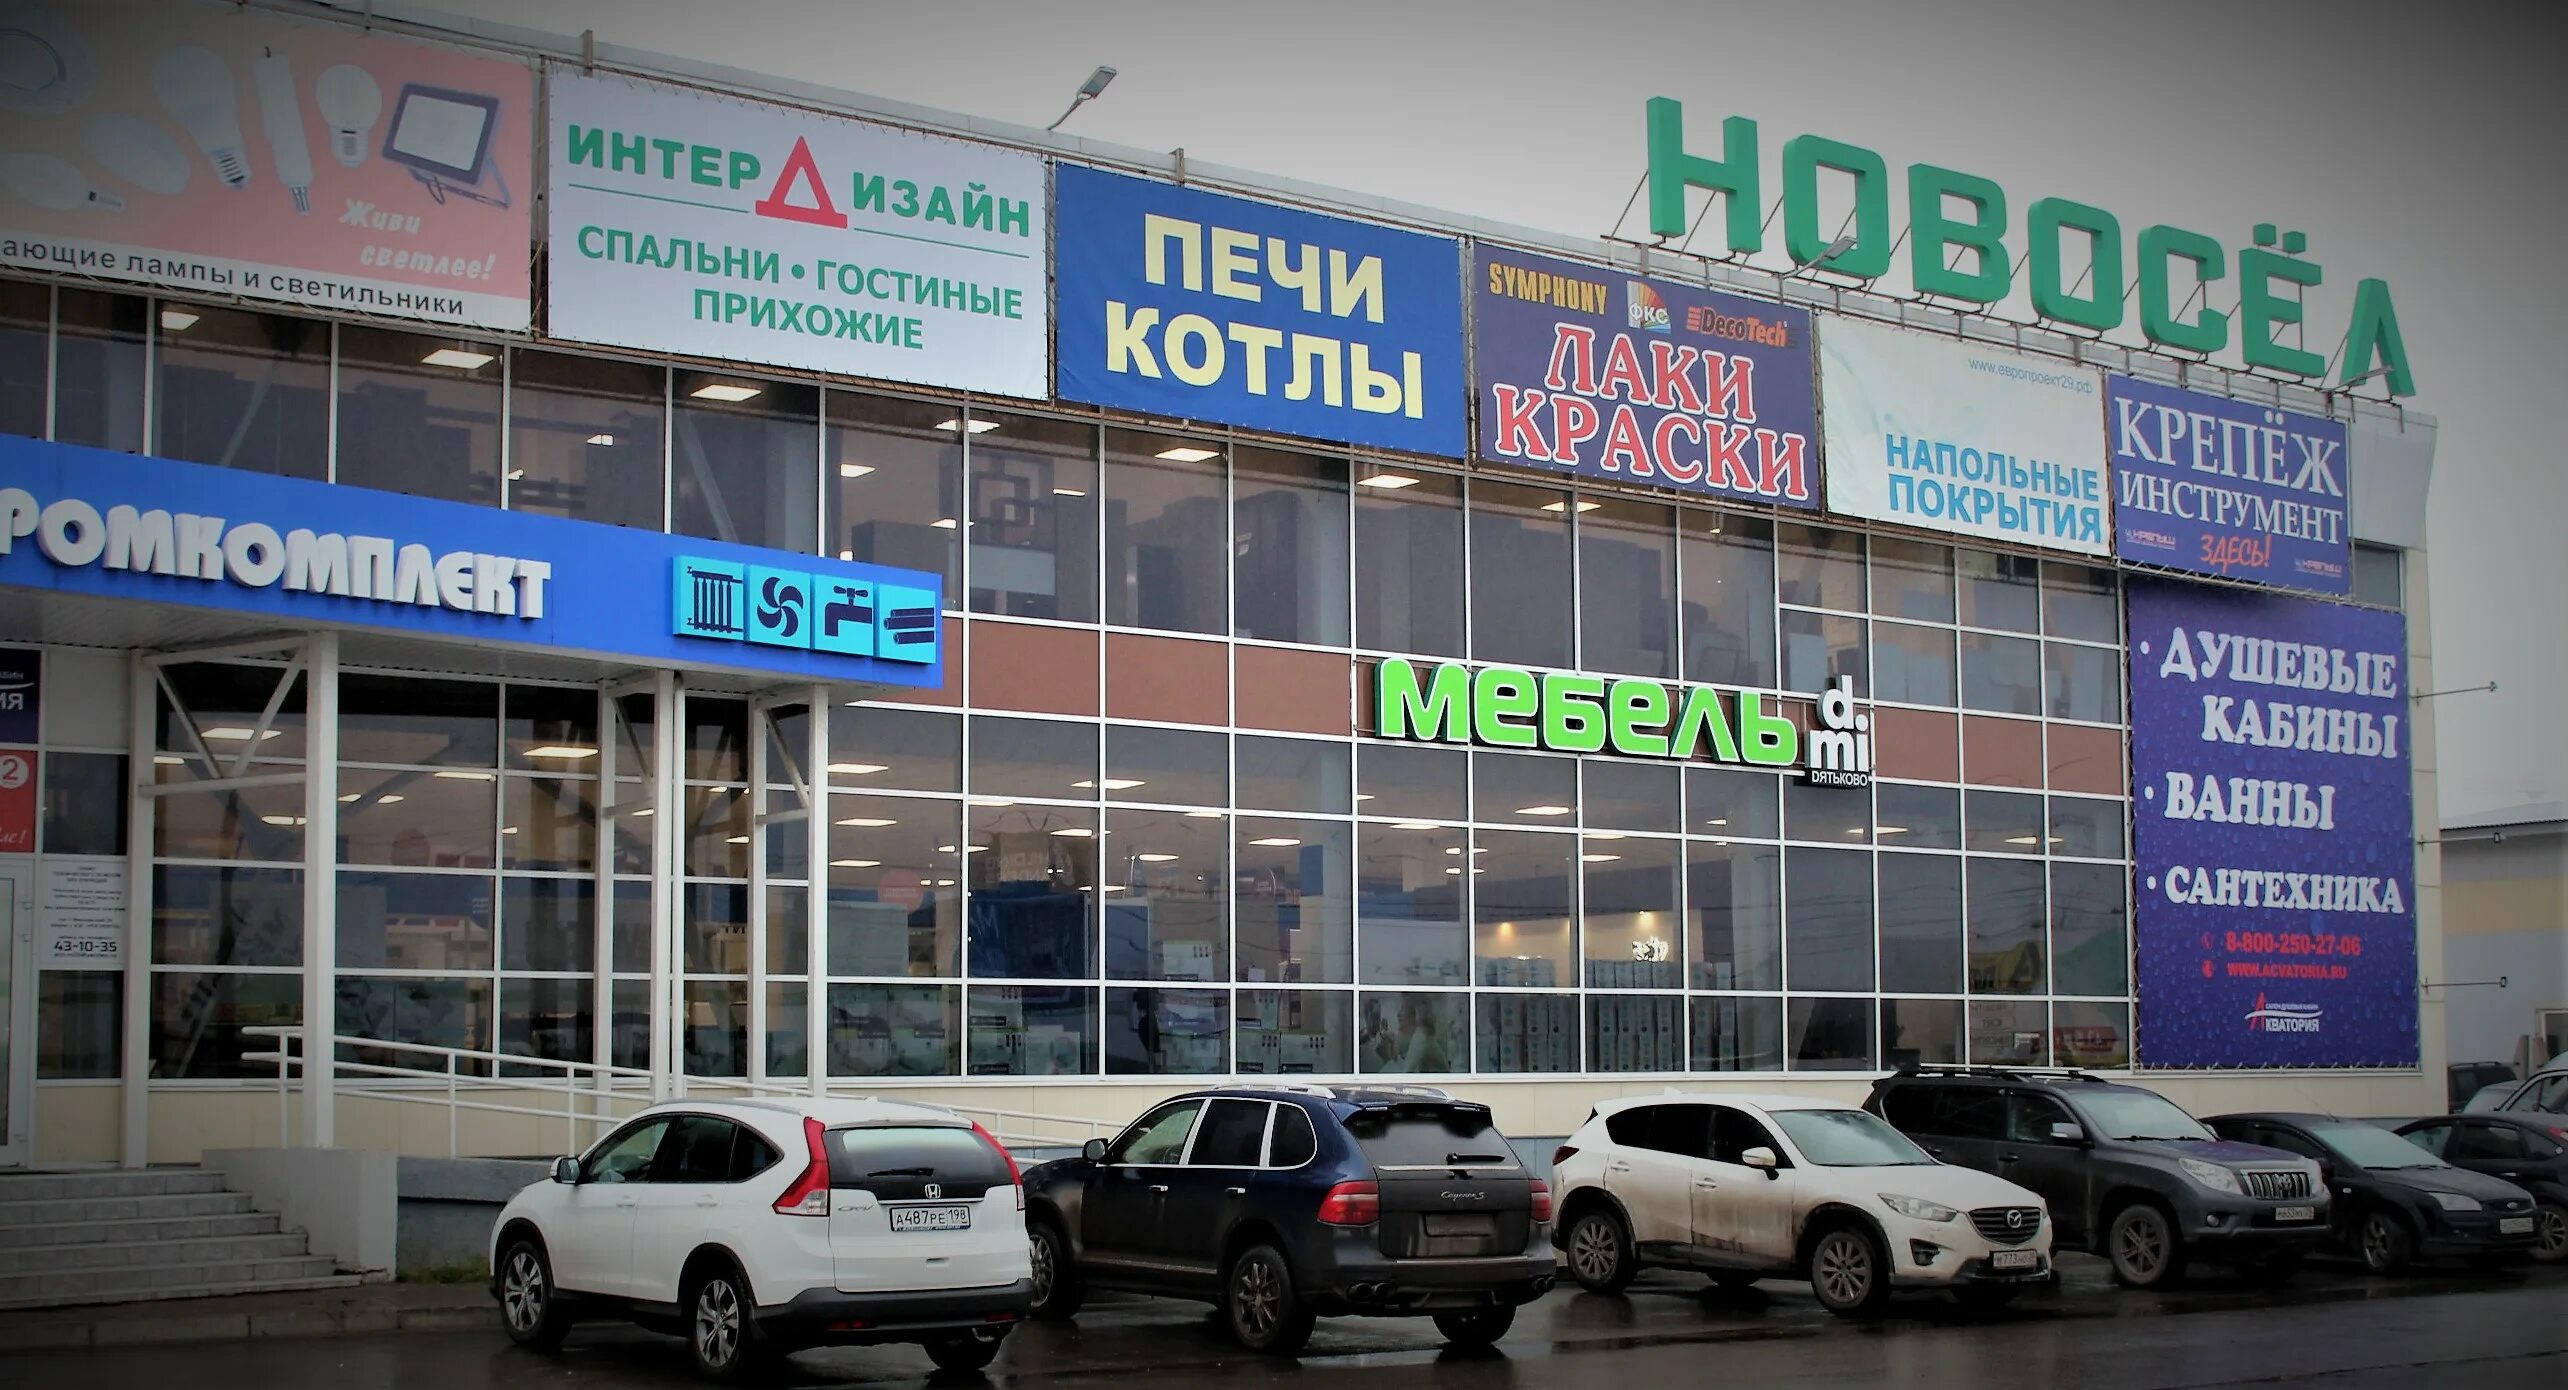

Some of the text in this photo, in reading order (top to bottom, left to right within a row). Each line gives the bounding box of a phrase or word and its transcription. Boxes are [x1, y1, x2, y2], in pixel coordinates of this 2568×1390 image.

[339, 199, 421, 234] Живи
[1646, 95, 2416, 397] НОВОСЁЛ
[126, 256, 233, 285] лампы
[244, 271, 259, 288] и
[270, 275, 463, 315] светильники
[360, 244, 497, 280] светлее!
[578, 226, 1023, 320] СПАЛЬНИ ГОСТИНЫЕ
[1145, 213, 1384, 323] ПЕЧИ
[1489, 263, 1608, 315] SYMPHONY
[694, 289, 923, 350] ПРИХОЖИЕ
[1701, 307, 1787, 348] DecoTech
[1106, 300, 1423, 419] КОТЛЫ
[1545, 322, 1757, 424] ЛАКИ
[1493, 383, 1809, 501] КРАСКИ
[1886, 433, 2099, 502] НАПОЛЬНЫЕ
[2115, 397, 2343, 498] КРЕПЁЖ
[1888, 473, 2101, 544] ПОКРЫТИЯ
[2119, 470, 2343, 545] ИНСТРУМЕНТ
[2200, 533, 2272, 574] ЗДЕСЬ!
[2160, 627, 2397, 699] ДУШЕВЫЕ
[2201, 695, 2398, 758] КАБИНЫ
[3, 758, 18, 780] 2
[2164, 771, 2335, 830] ВАННЫ
[2165, 865, 2405, 914] САНТЕХНИКА
[54, 941, 117, 952] 43-10-35
[2226, 931, 2361, 956] 8-800-250-27-06
[2227, 962, 2347, 978] WWW.ACVATORIA.RU
[948, 1209, 967, 1219] 198
